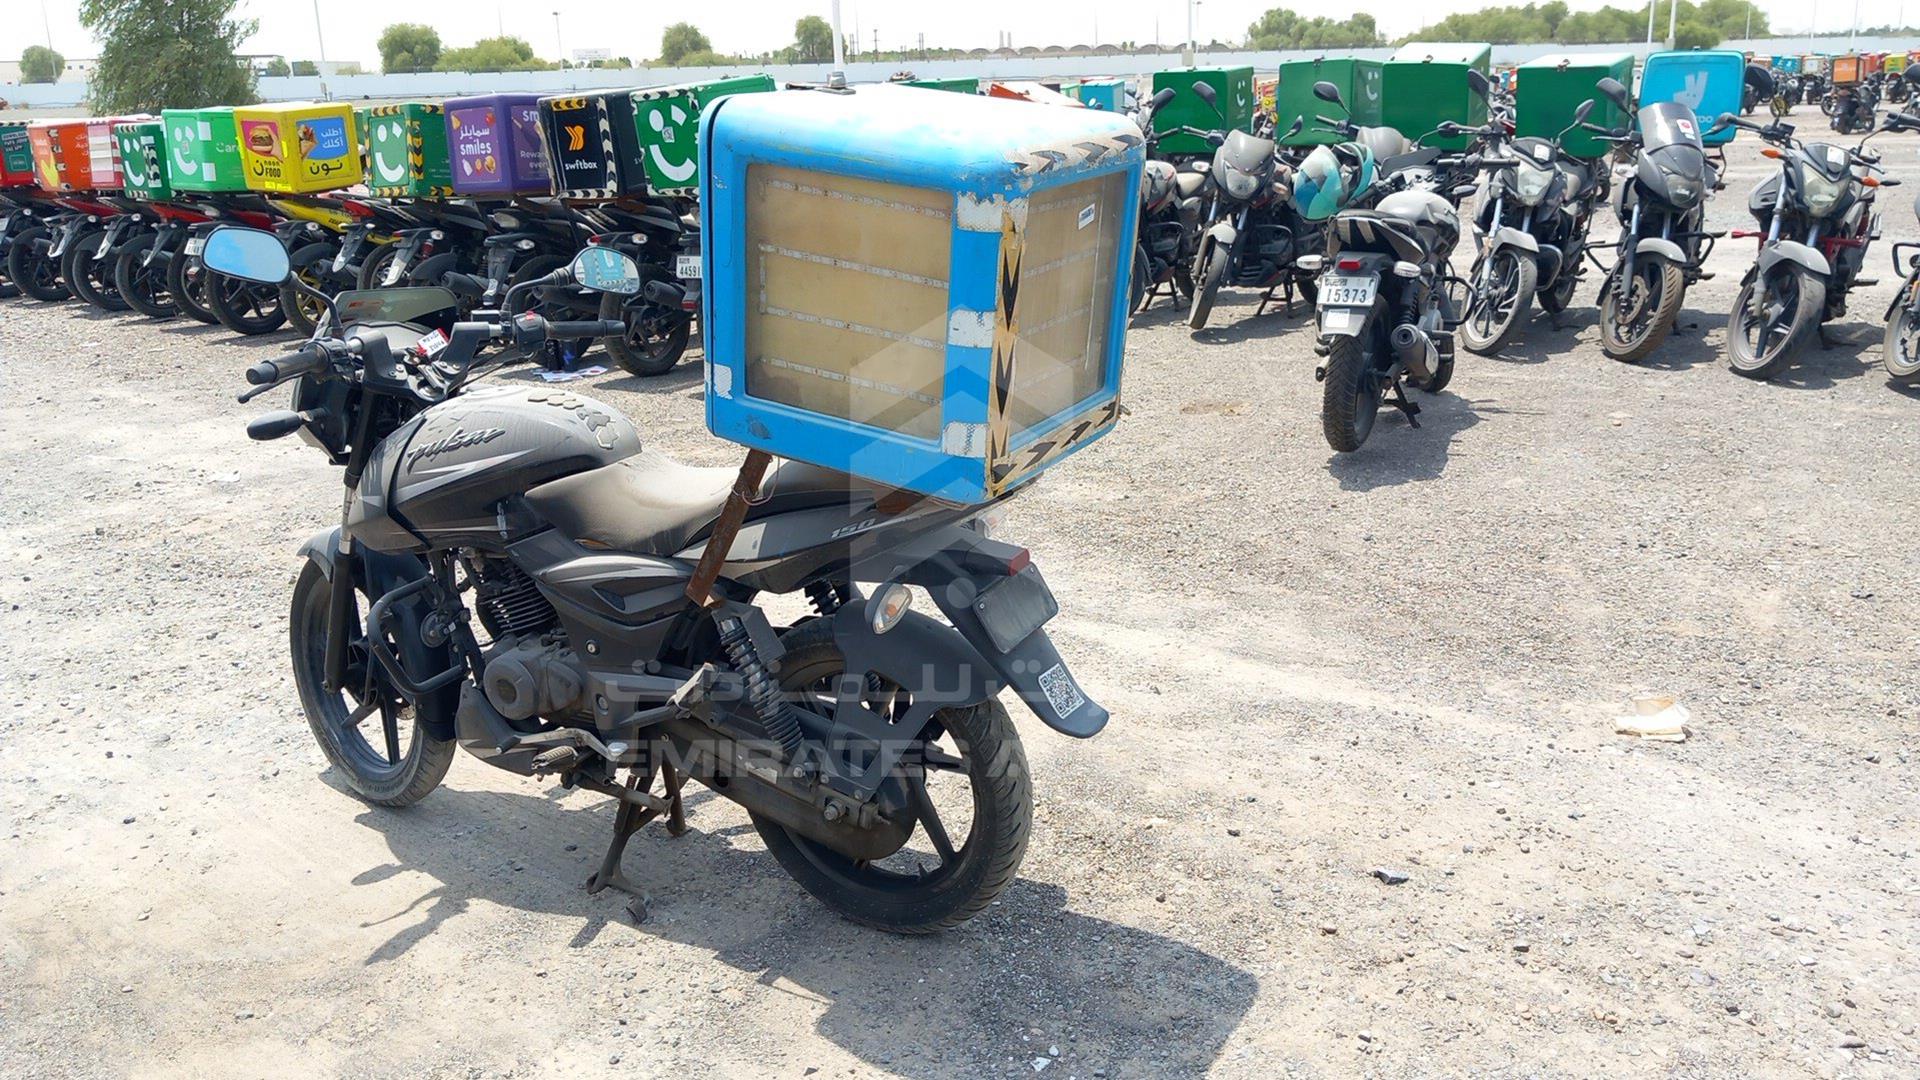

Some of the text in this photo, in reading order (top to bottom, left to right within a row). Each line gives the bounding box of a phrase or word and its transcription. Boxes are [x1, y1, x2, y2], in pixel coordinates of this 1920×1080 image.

[460, 139, 492, 155] smiles
[565, 159, 598, 171] swftbox
[265, 167, 281, 178] FOOD
[1326, 289, 1367, 303] 15373
[831, 518, 876, 539] 150
